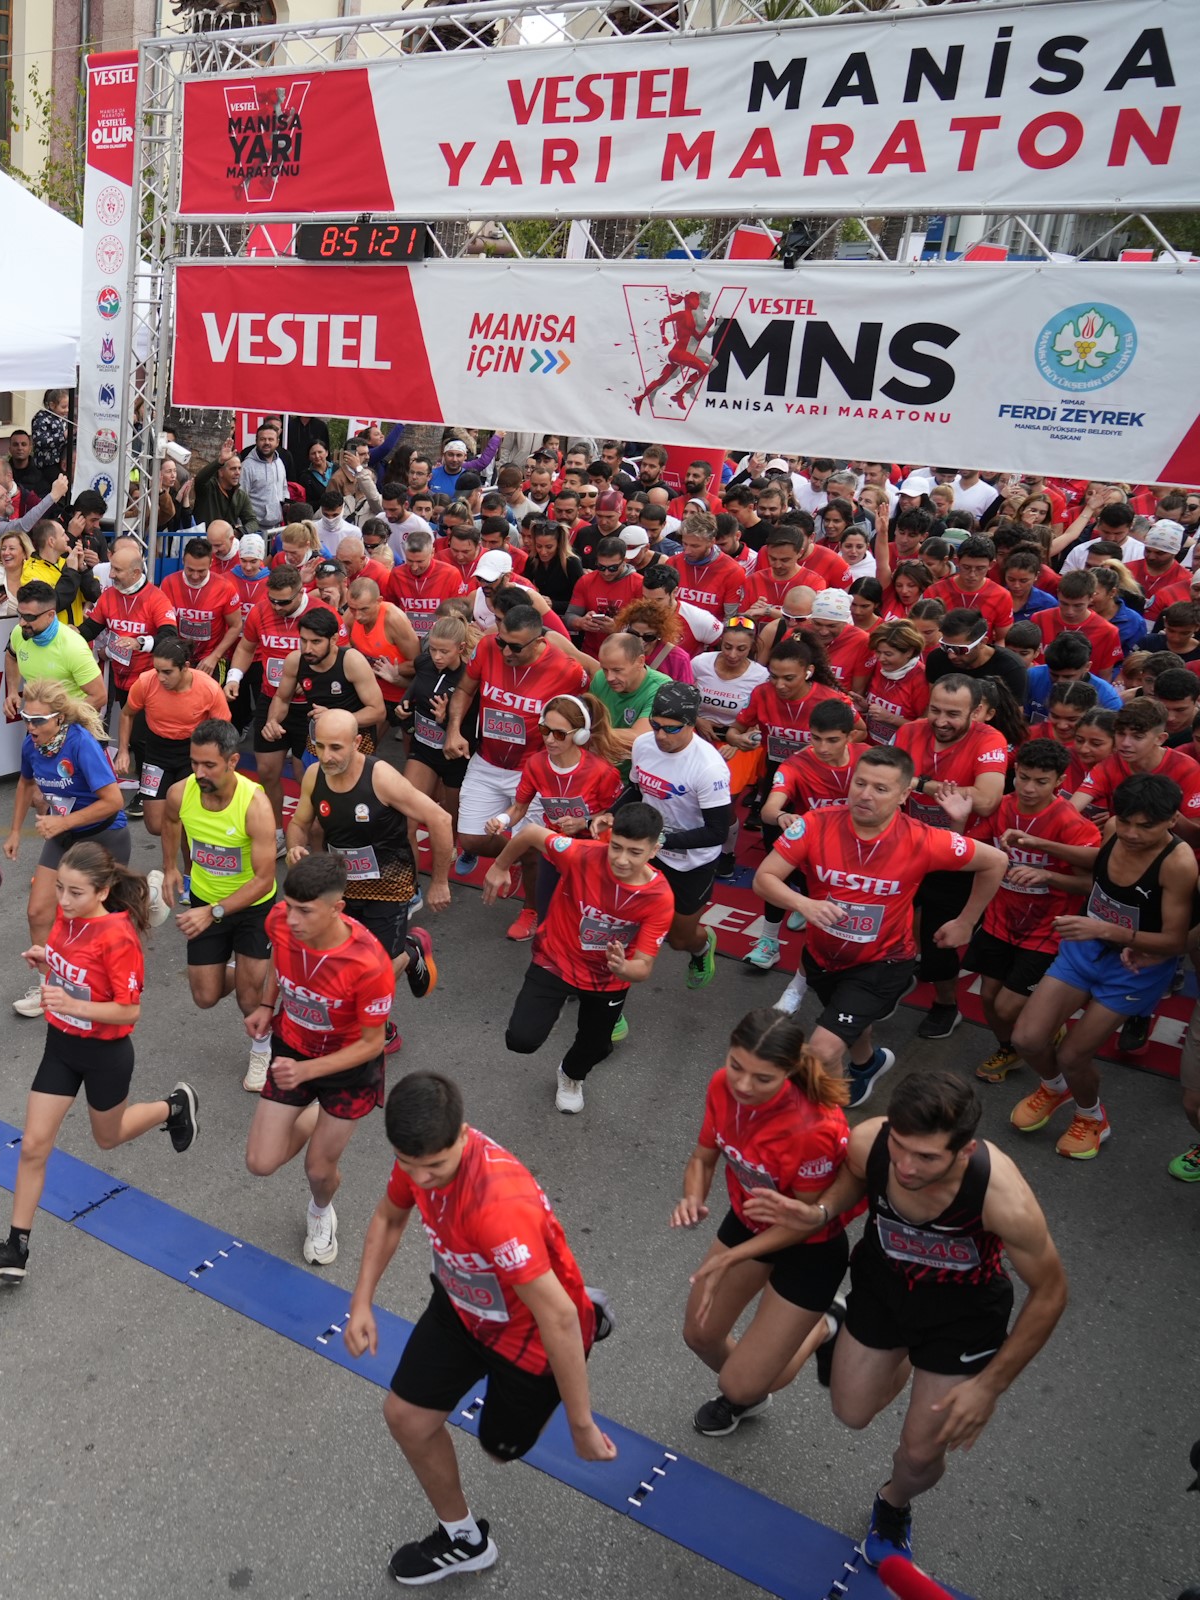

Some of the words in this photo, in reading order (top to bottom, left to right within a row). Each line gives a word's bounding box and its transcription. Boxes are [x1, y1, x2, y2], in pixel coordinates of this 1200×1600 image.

[93, 68, 136, 87] VESTEL
[506, 66, 702, 126] VESTEL
[230, 102, 256, 112] VESTEL
[91, 126, 134, 145] OLUR
[229, 132, 302, 165] YARI
[438, 136, 612, 187] YARI
[660, 106, 1182, 182] MARATON
[226, 164, 300, 179] MARATONU
[319, 226, 417, 257] 8:51:21
[748, 298, 818, 316] VESTEL
[201, 312, 392, 370] VESTEL
[706, 317, 961, 406] MNS
[784, 403, 828, 416] YARI
[838, 406, 952, 424] MARATONU
[1059, 408, 1147, 428] ZEYREK
[172, 606, 217, 621] VESTEL
[105, 618, 149, 635] VESTEL
[702, 686, 743, 700] MERRELL
[703, 696, 738, 710] BOLD
[487, 718, 523, 736] 5450
[195, 849, 239, 870] 5623
[815, 864, 902, 897] VESTEL
[834, 914, 874, 932] 218
[1092, 897, 1133, 930] 5593
[44, 943, 90, 987] ESTEL
[797, 1161, 833, 1178] OLUR
[493, 1244, 531, 1269] OLUR
[888, 1231, 971, 1262] 5546
